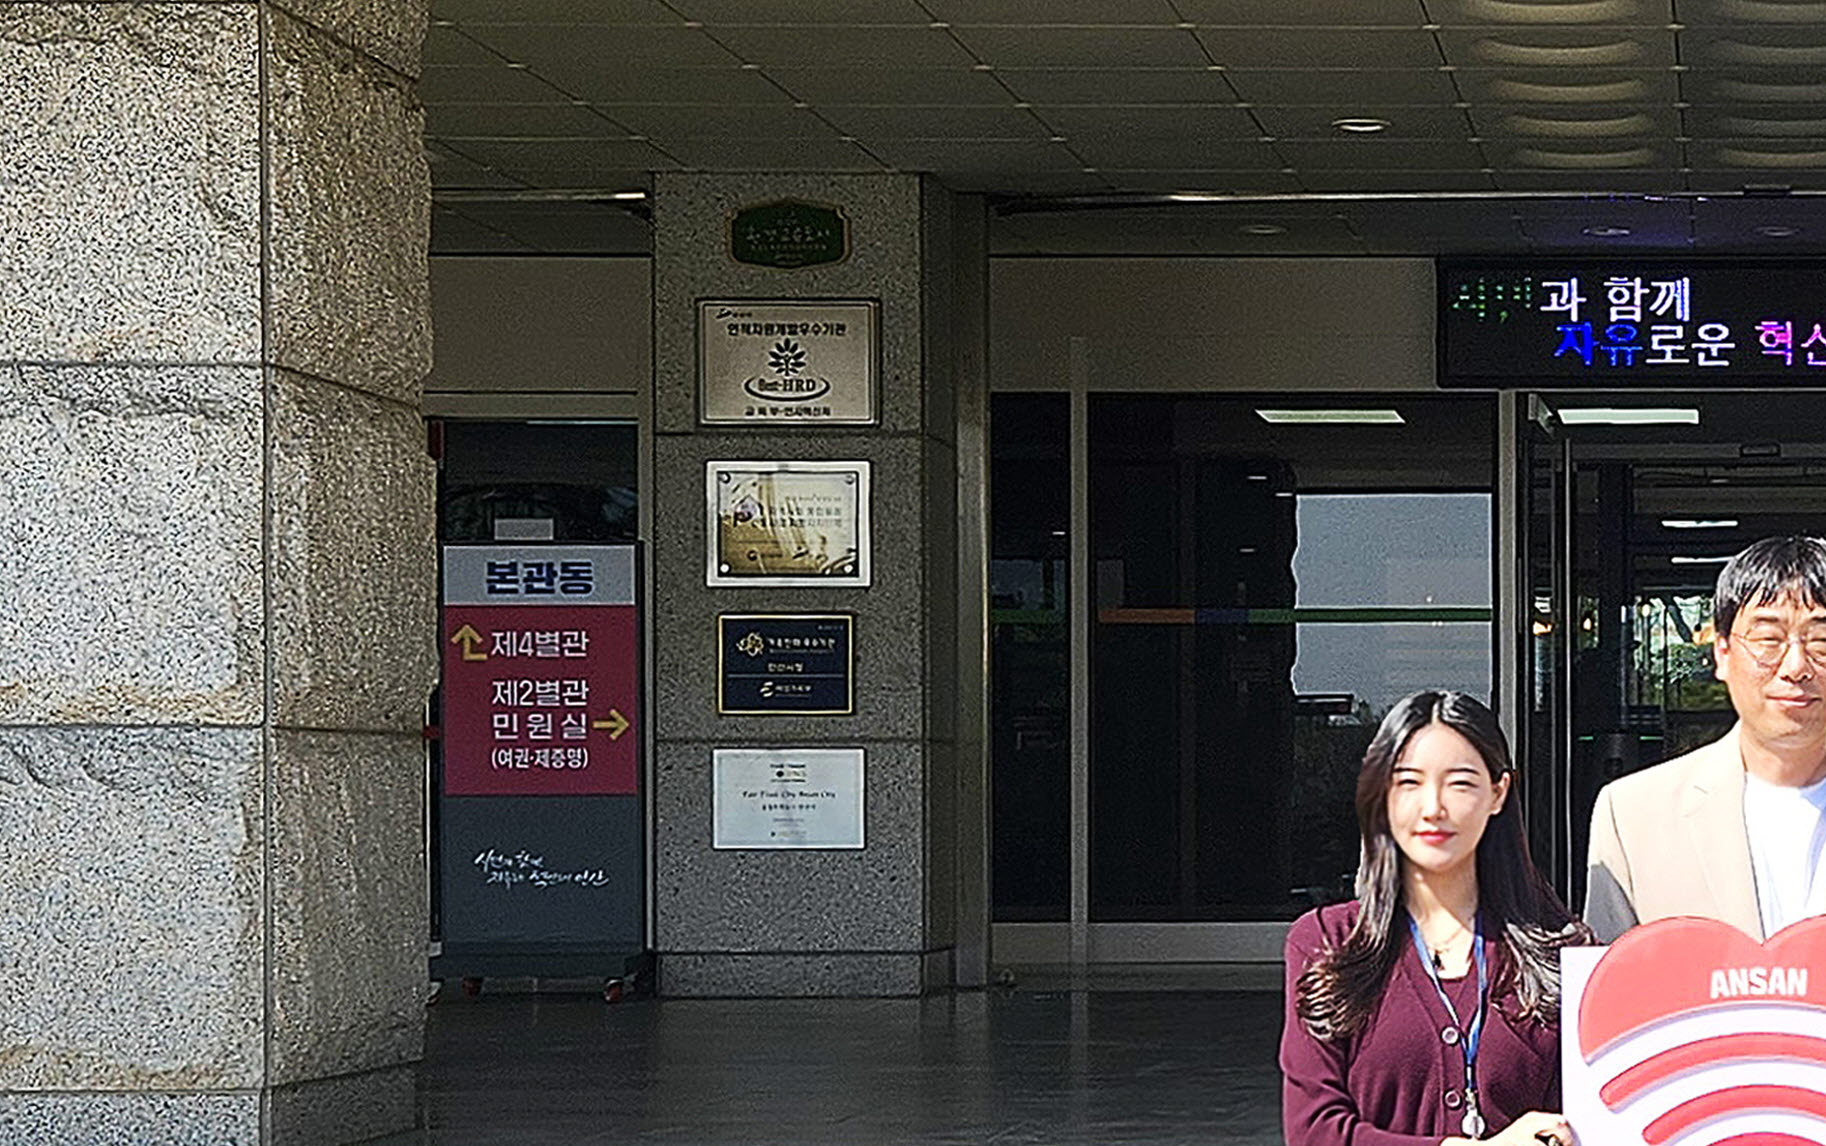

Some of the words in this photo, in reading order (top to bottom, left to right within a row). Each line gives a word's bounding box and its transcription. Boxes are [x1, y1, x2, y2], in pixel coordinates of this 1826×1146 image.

[1603, 276, 1692, 323] 함께
[1553, 320, 1736, 368] 자유로운
[486, 561, 593, 595] 본관동
[491, 630, 589, 658] 제4별관
[491, 680, 589, 707] 제2별관
[1710, 967, 1808, 999] ANSAN
